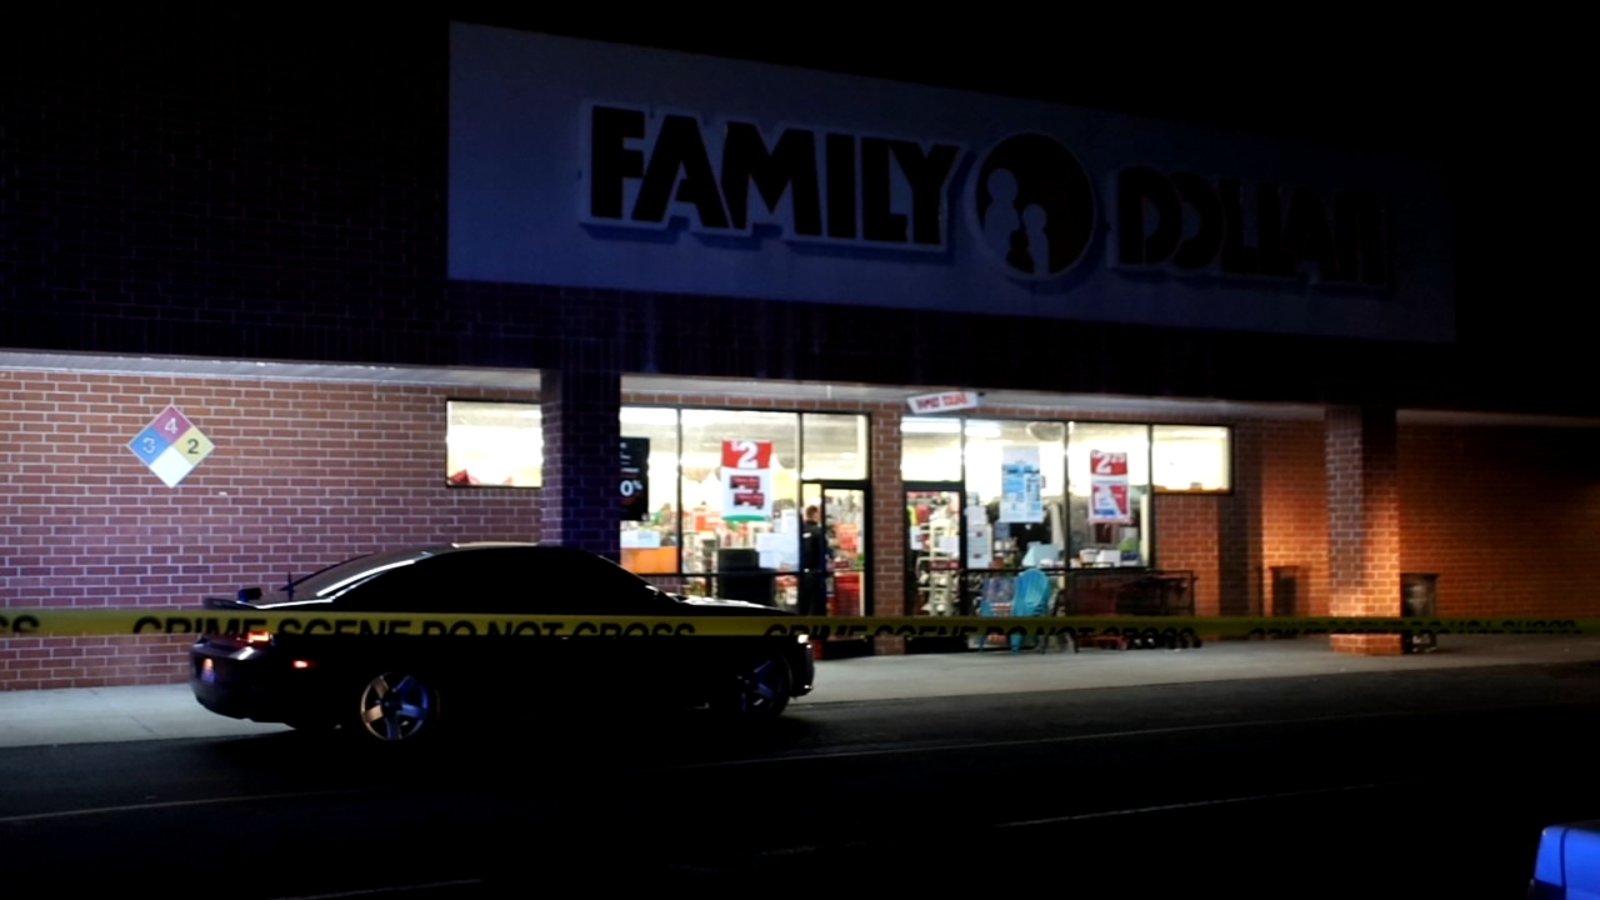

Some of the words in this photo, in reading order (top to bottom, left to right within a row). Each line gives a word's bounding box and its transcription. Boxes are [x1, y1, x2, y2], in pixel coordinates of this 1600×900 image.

[591, 105, 960, 245] FAMILY
[1119, 167, 1387, 286] DOLLAR
[164, 417, 179, 434] 4
[142, 437, 156, 454] 3
[187, 438, 200, 454] 2
